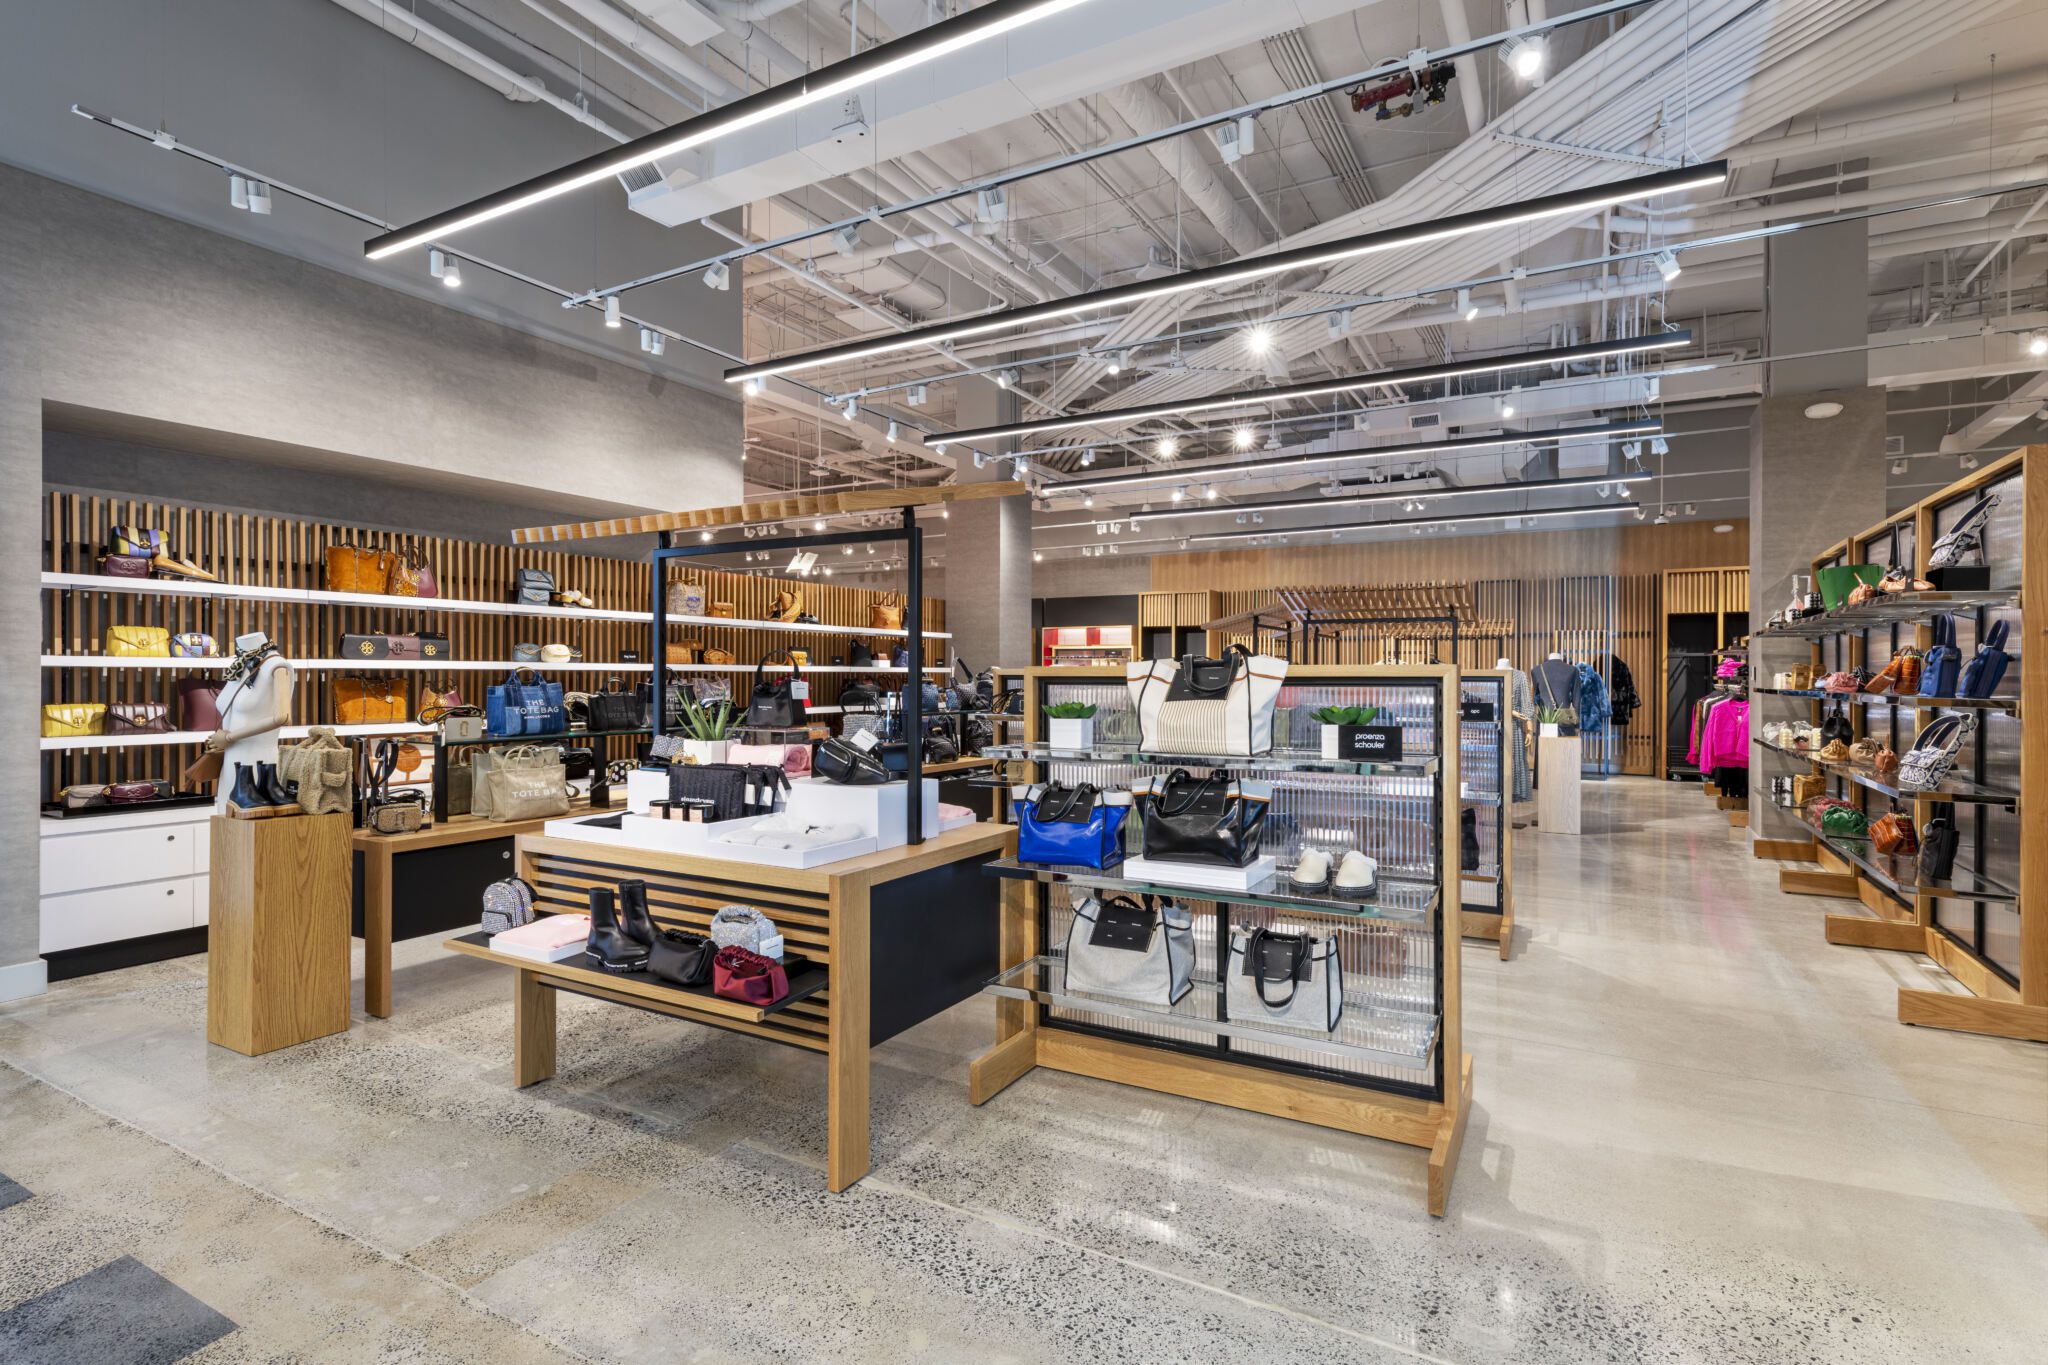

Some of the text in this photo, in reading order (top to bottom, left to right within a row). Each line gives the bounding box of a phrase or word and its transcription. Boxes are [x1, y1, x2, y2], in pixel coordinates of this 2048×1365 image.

[513, 705, 560, 715] TOTE BAG
[1355, 733, 1386, 741] proenza
[1354, 741, 1385, 749] schouler
[511, 789, 541, 798] TOTE
